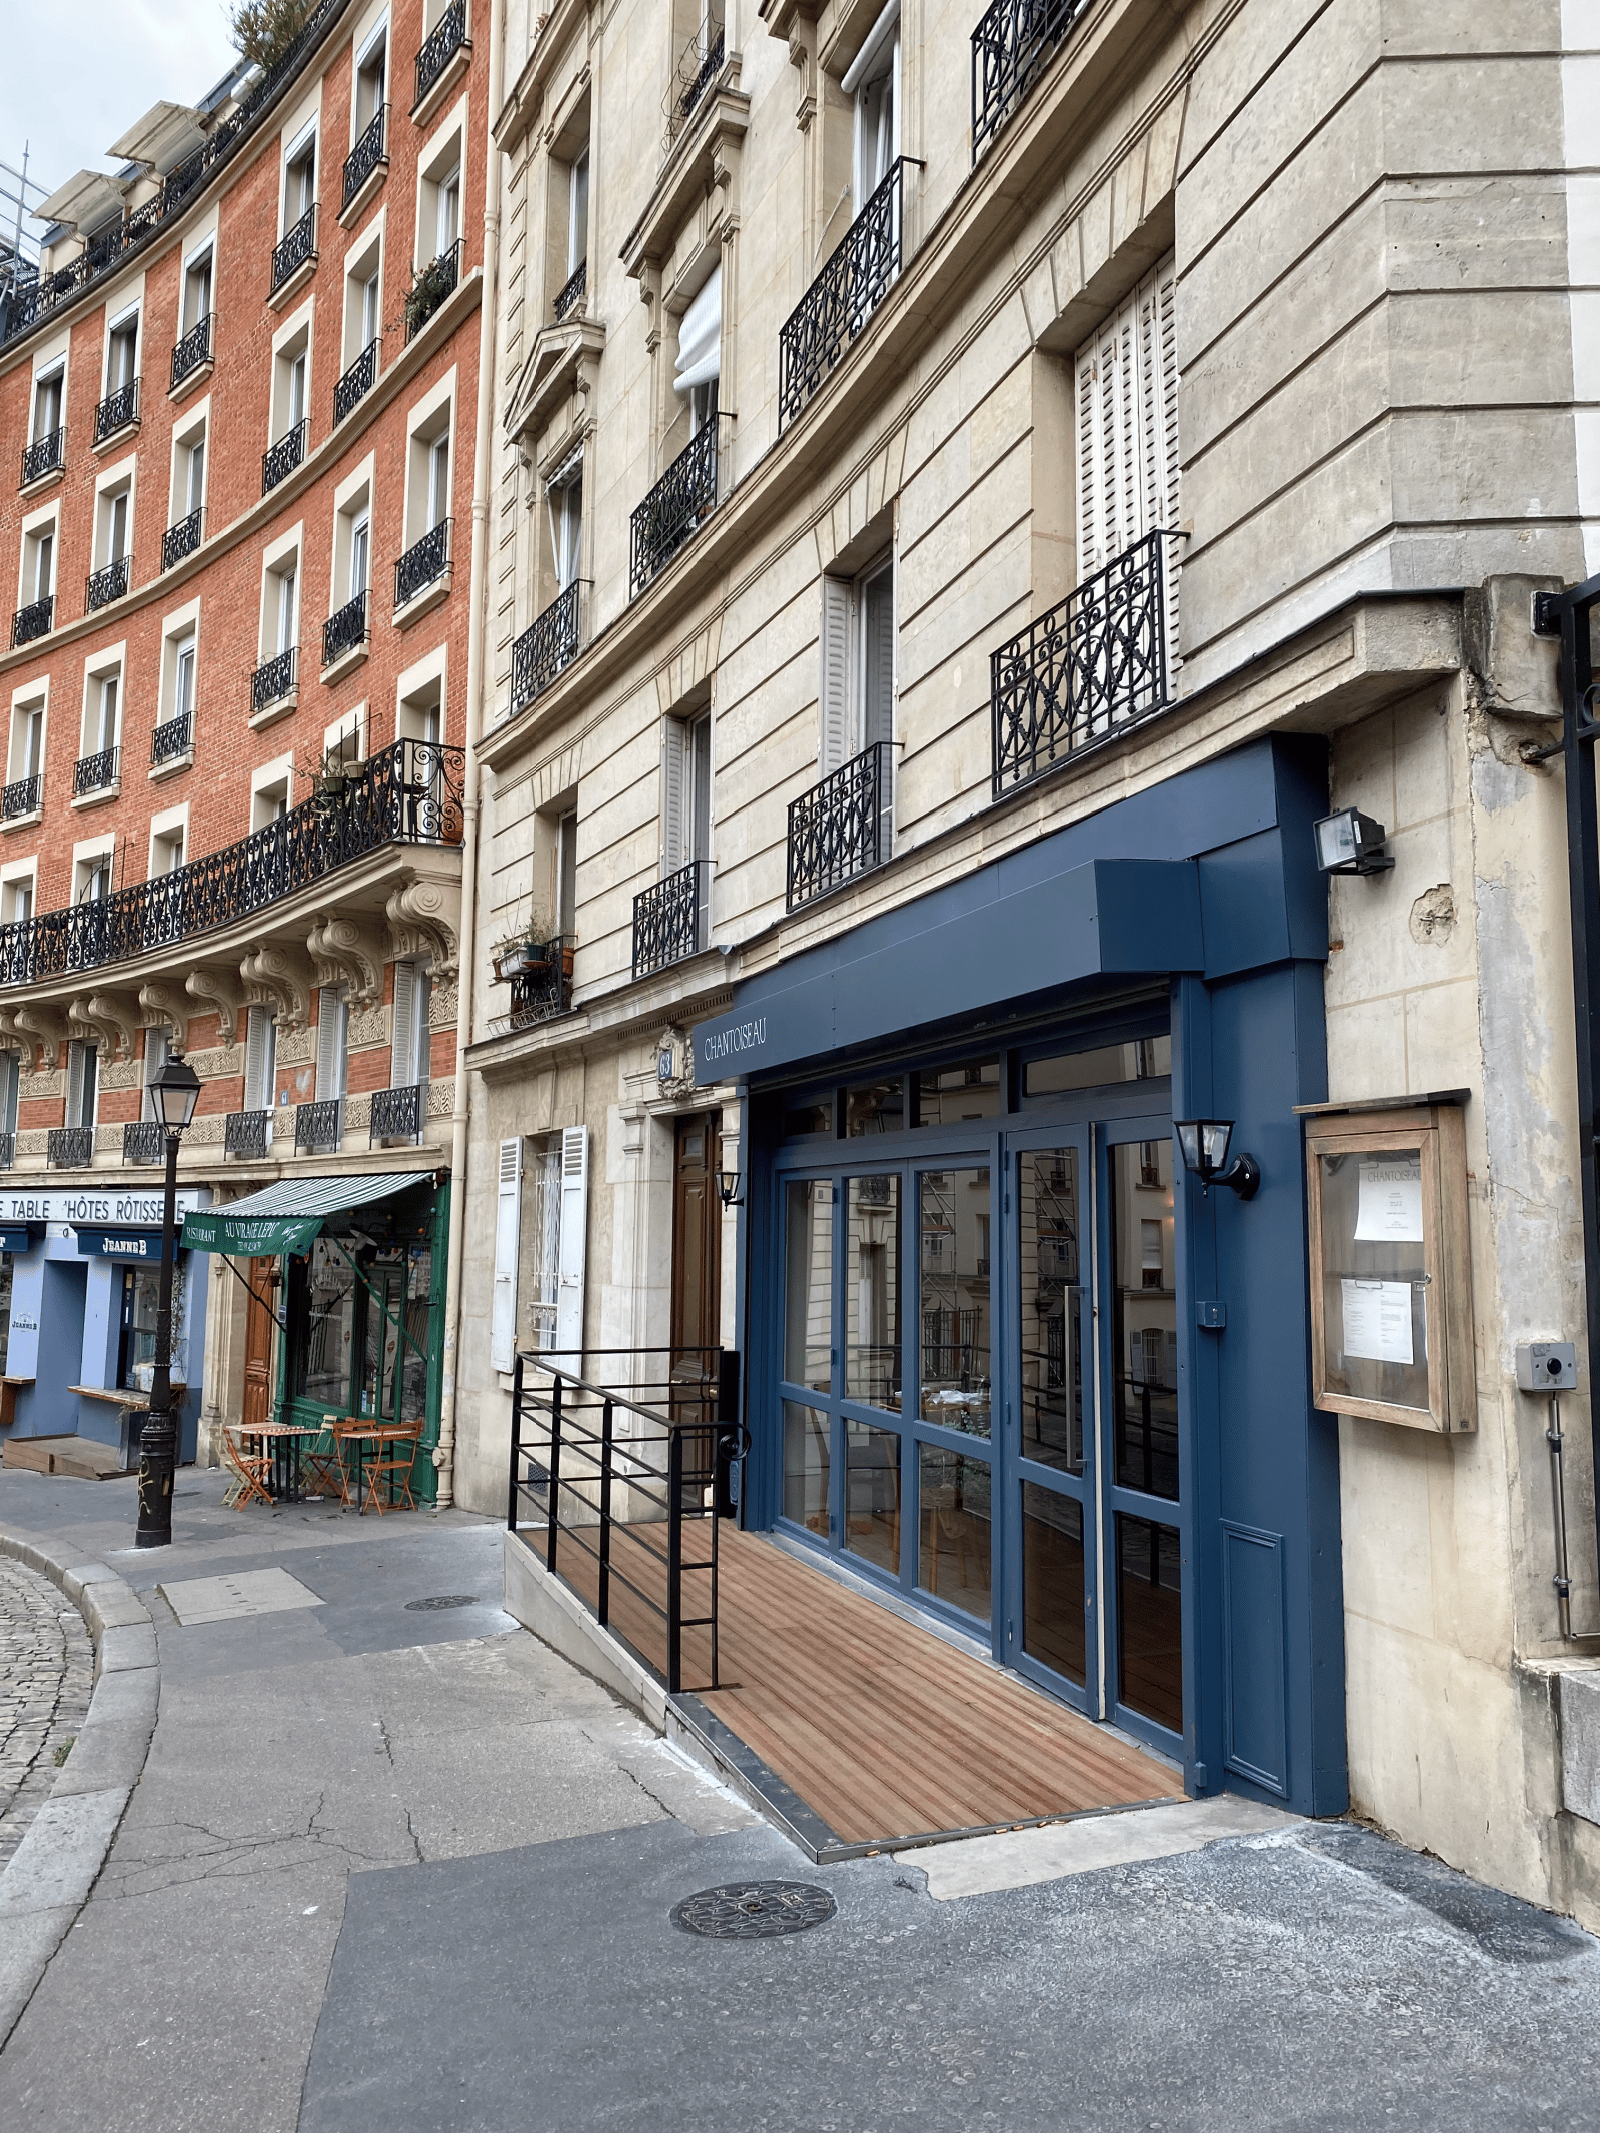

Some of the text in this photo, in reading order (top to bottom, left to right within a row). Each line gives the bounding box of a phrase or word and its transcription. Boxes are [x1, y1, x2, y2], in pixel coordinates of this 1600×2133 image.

[704, 1017, 767, 1061] CHANTOISEAU
[659, 1053, 670, 1075] 63
[11, 1200, 50, 1219] TABLE
[116, 1194, 185, 1222] RÔTISSEE
[225, 1221, 235, 1238] AU
[102, 1237, 147, 1256] JEANNE B
